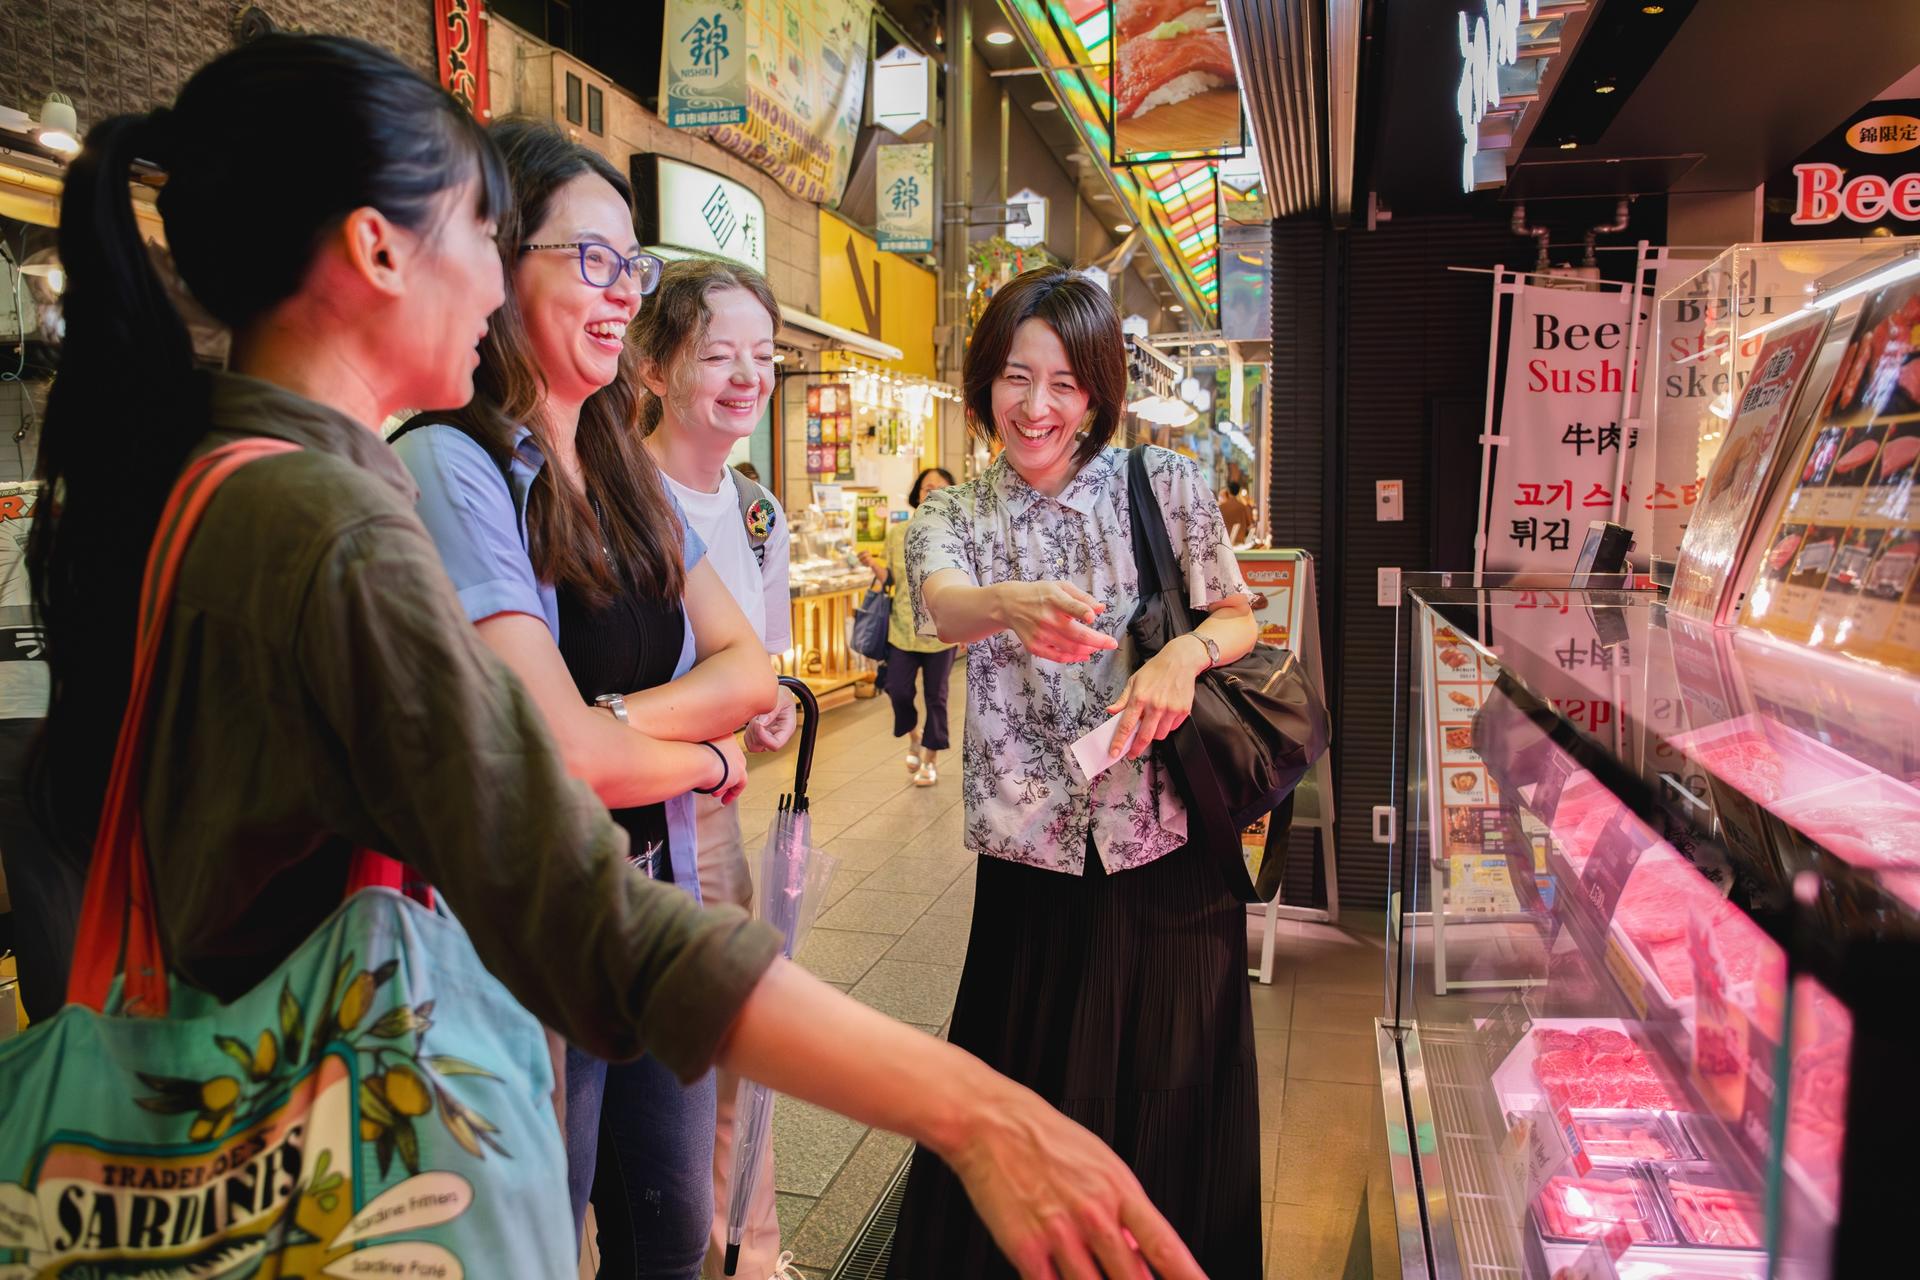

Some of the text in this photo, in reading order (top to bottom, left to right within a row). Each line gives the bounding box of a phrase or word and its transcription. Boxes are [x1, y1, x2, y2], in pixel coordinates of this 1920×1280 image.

[680, 13, 731, 78] 錦
[681, 67, 713, 78] NISHIKI
[1859, 124, 1919, 144] 錦限定
[885, 176, 920, 218] 錦
[1792, 163, 1920, 225] Bee
[1528, 359, 1639, 393] Sushi
[1514, 480, 1573, 511] 고기
[1509, 517, 1570, 551] 튀김
